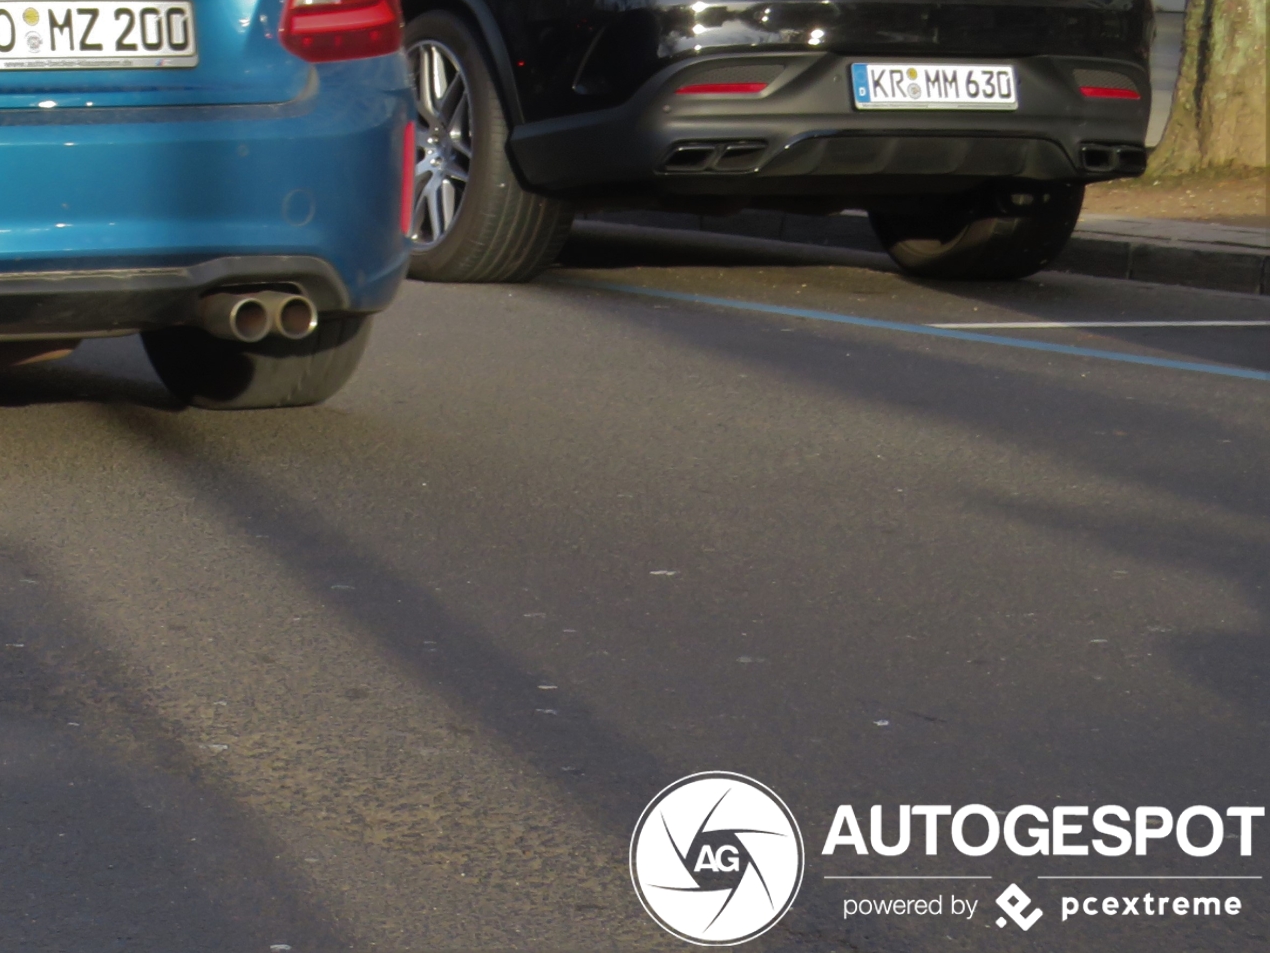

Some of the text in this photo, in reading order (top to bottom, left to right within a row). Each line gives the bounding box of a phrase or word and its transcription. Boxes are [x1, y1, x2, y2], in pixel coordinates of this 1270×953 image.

[48, 8, 103, 52] MZ
[114, 7, 189, 52] 200
[871, 69, 906, 99] KR
[924, 69, 960, 99] MM
[966, 70, 1012, 99] 630
